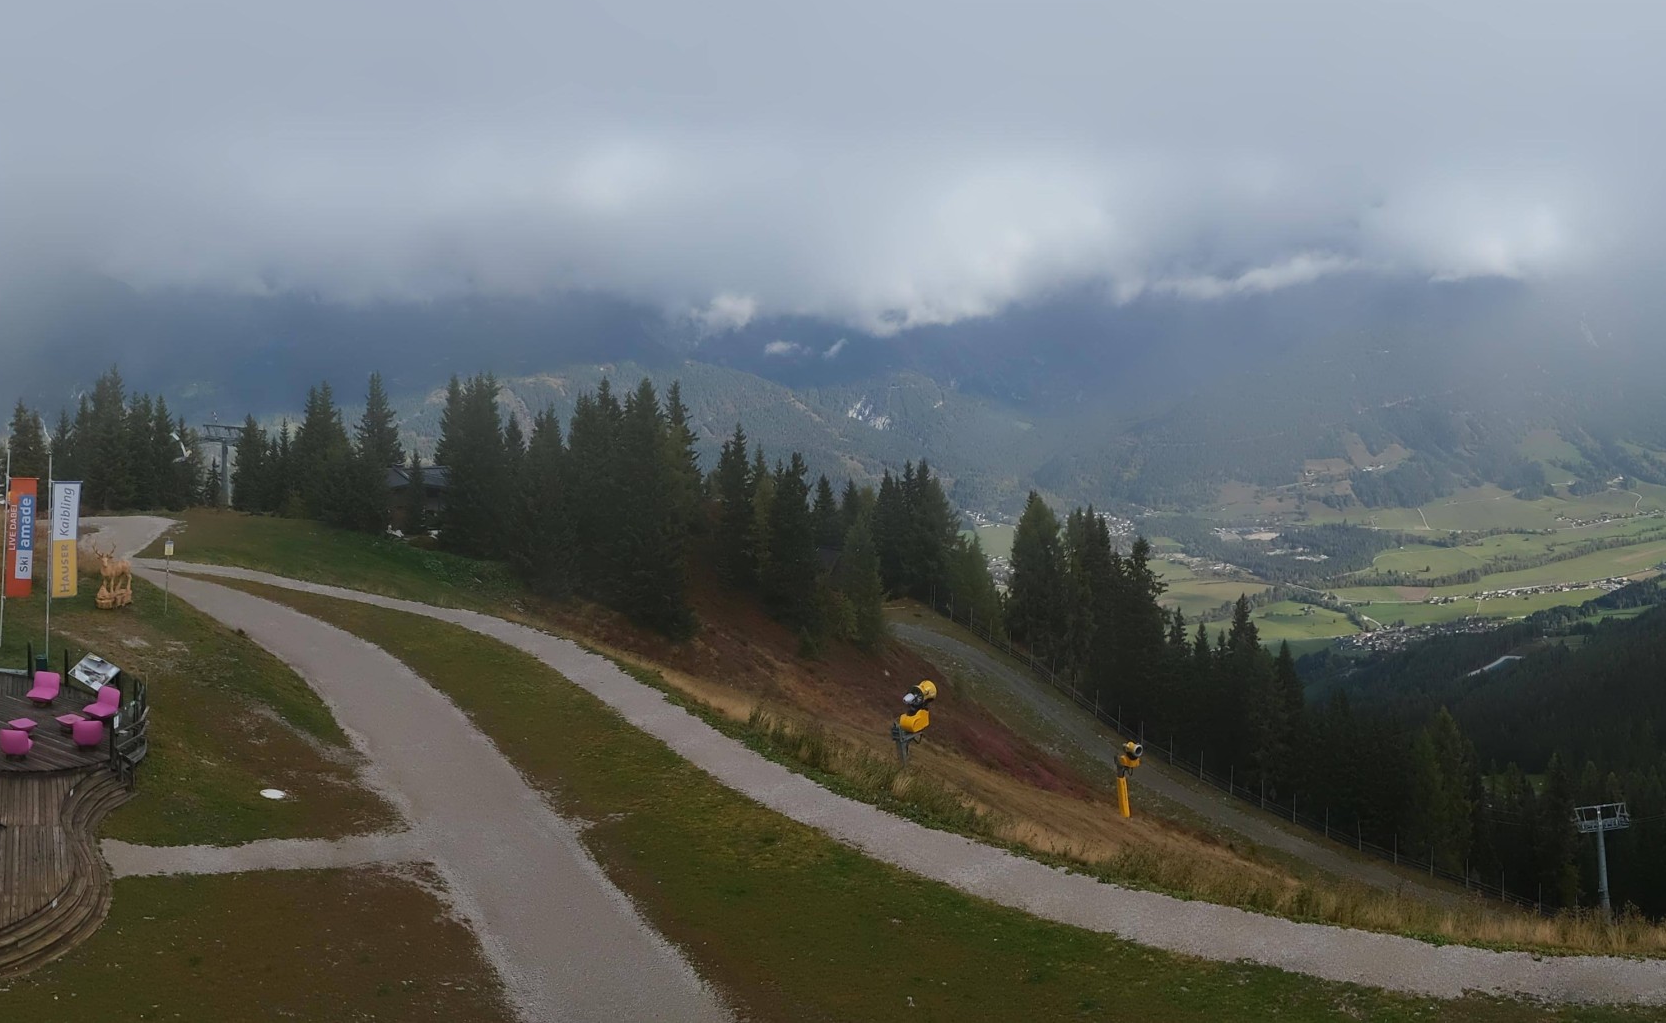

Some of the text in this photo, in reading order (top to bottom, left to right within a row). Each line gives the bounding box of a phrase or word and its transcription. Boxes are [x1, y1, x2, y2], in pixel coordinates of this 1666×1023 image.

[8, 504, 18, 551] LIVE DABEI
[20, 497, 32, 572] Ski amade
[59, 487, 75, 593] HAUSER Kaibling
